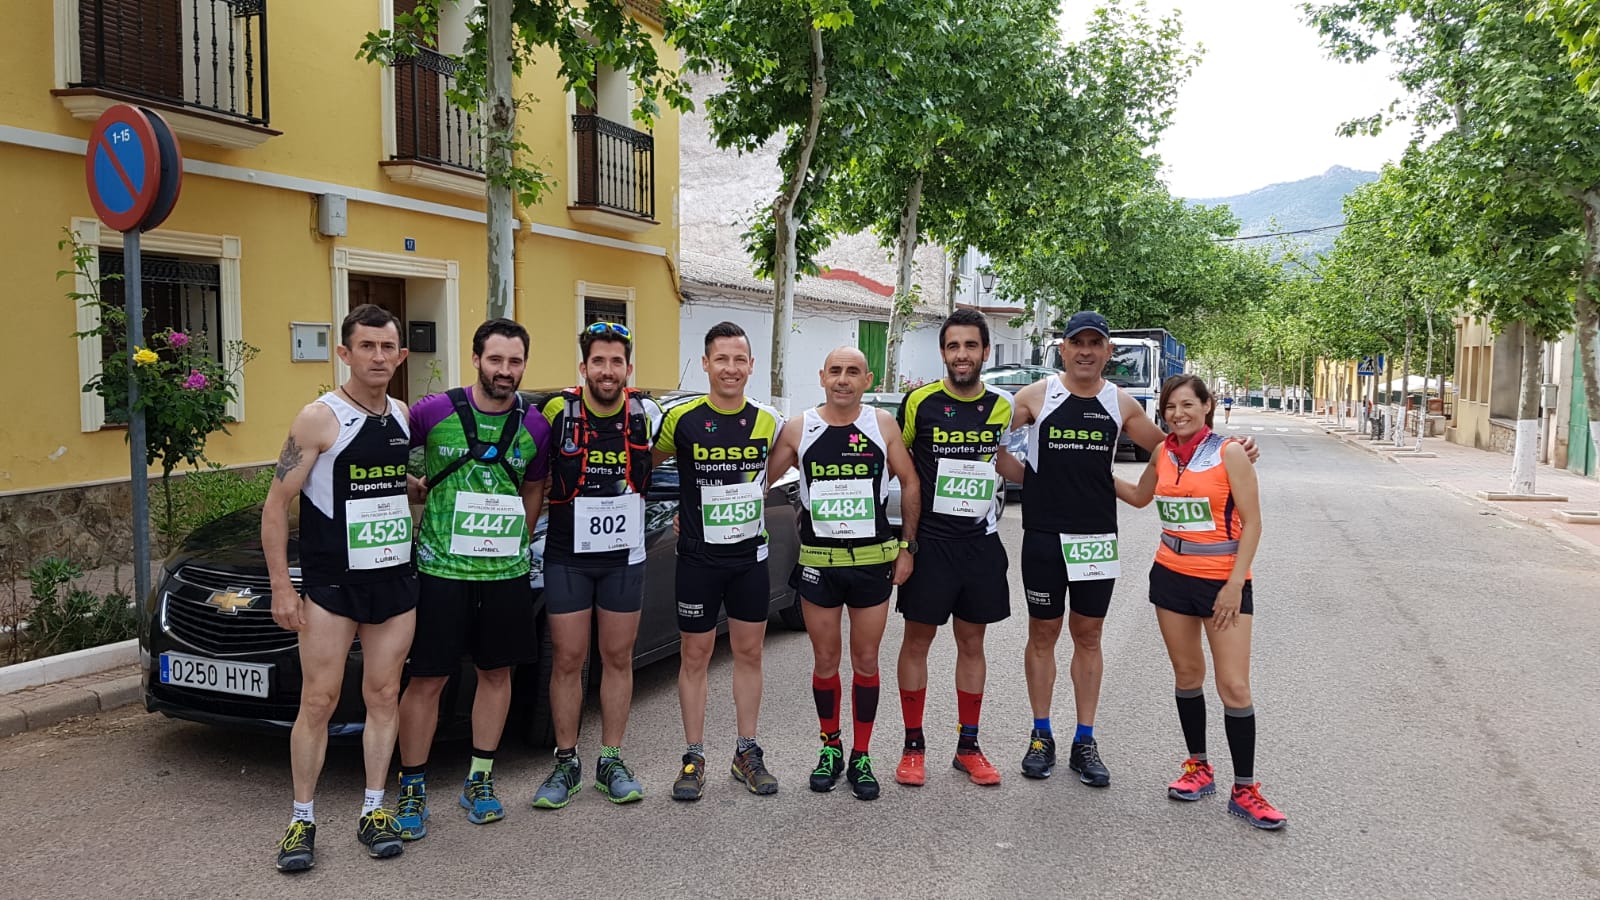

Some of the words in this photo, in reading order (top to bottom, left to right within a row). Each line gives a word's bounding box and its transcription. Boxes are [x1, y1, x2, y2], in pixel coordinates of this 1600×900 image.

[112, 129, 130, 144] 1-15
[932, 443, 975, 455] Deportes
[1048, 442, 1084, 450] Deportes
[586, 450, 627, 464] ase
[615, 466, 627, 475] Jo
[695, 462, 737, 473] Deportes
[350, 481, 392, 492] Deportes
[943, 477, 987, 498] 4461
[709, 501, 757, 523] 4458
[817, 498, 868, 518] 4484
[1162, 502, 1204, 521] 4510
[357, 518, 407, 545] 4529
[460, 513, 517, 535] 4447
[589, 514, 626, 535] 802
[1069, 541, 1114, 561] 4528
[172, 659, 218, 686] 0250
[226, 666, 262, 693] HYR
